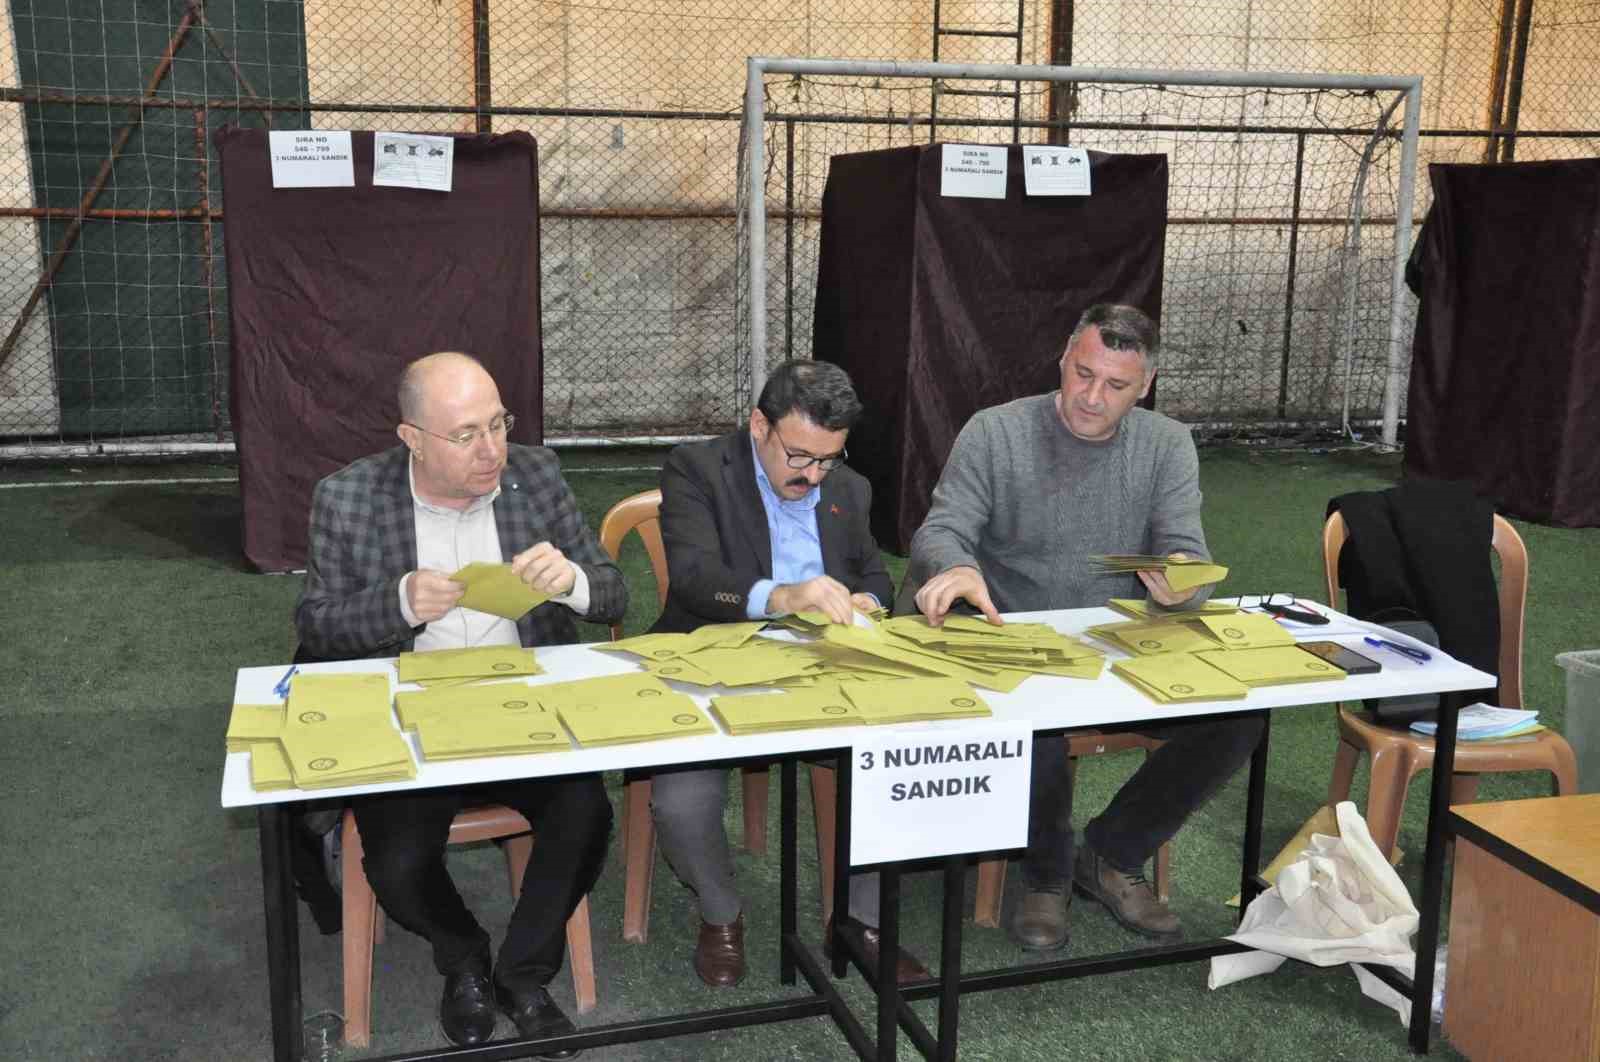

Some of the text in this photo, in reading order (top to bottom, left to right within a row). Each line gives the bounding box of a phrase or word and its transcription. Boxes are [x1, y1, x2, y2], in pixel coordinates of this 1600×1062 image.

[860, 739, 1023, 770] 3 NUMARALI
[891, 775, 992, 801] SANDIK
